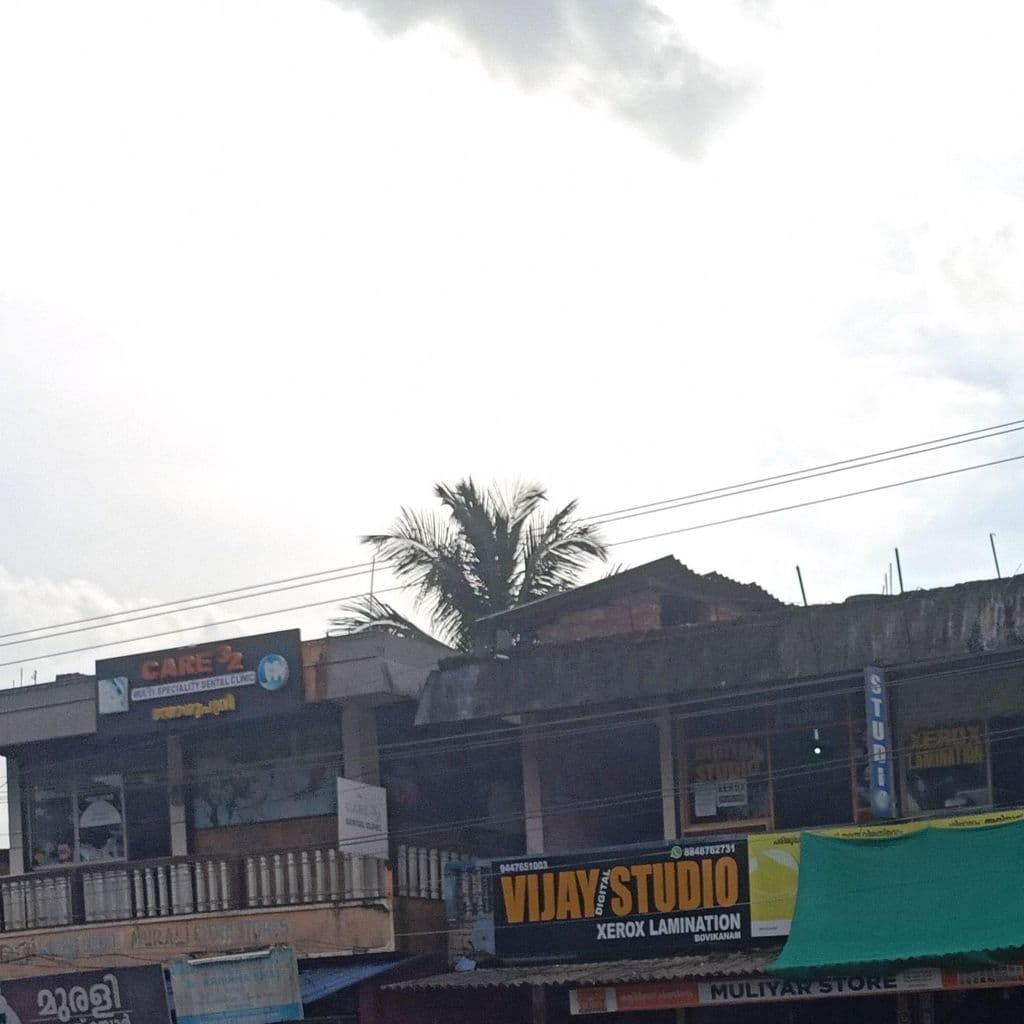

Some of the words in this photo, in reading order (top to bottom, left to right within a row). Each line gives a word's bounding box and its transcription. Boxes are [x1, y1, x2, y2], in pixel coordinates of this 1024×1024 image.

[141, 654, 214, 681] CARE
[158, 682, 200, 698] SPECIALITY
[201, 678, 230, 690] DENTAL
[231, 673, 256, 686] CLINIC
[500, 868, 601, 924] VIJAY
[594, 868, 611, 917] DIGITAL
[610, 856, 739, 917] STUDIO
[597, 921, 646, 941] XEROX
[649, 913, 741, 936] LAMINATION
[694, 931, 742, 943] BOVIKANAM
[37, 973, 122, 1022] മുരളി
[711, 978, 812, 1000] MULIYAR
[819, 975, 897, 995] STORE
